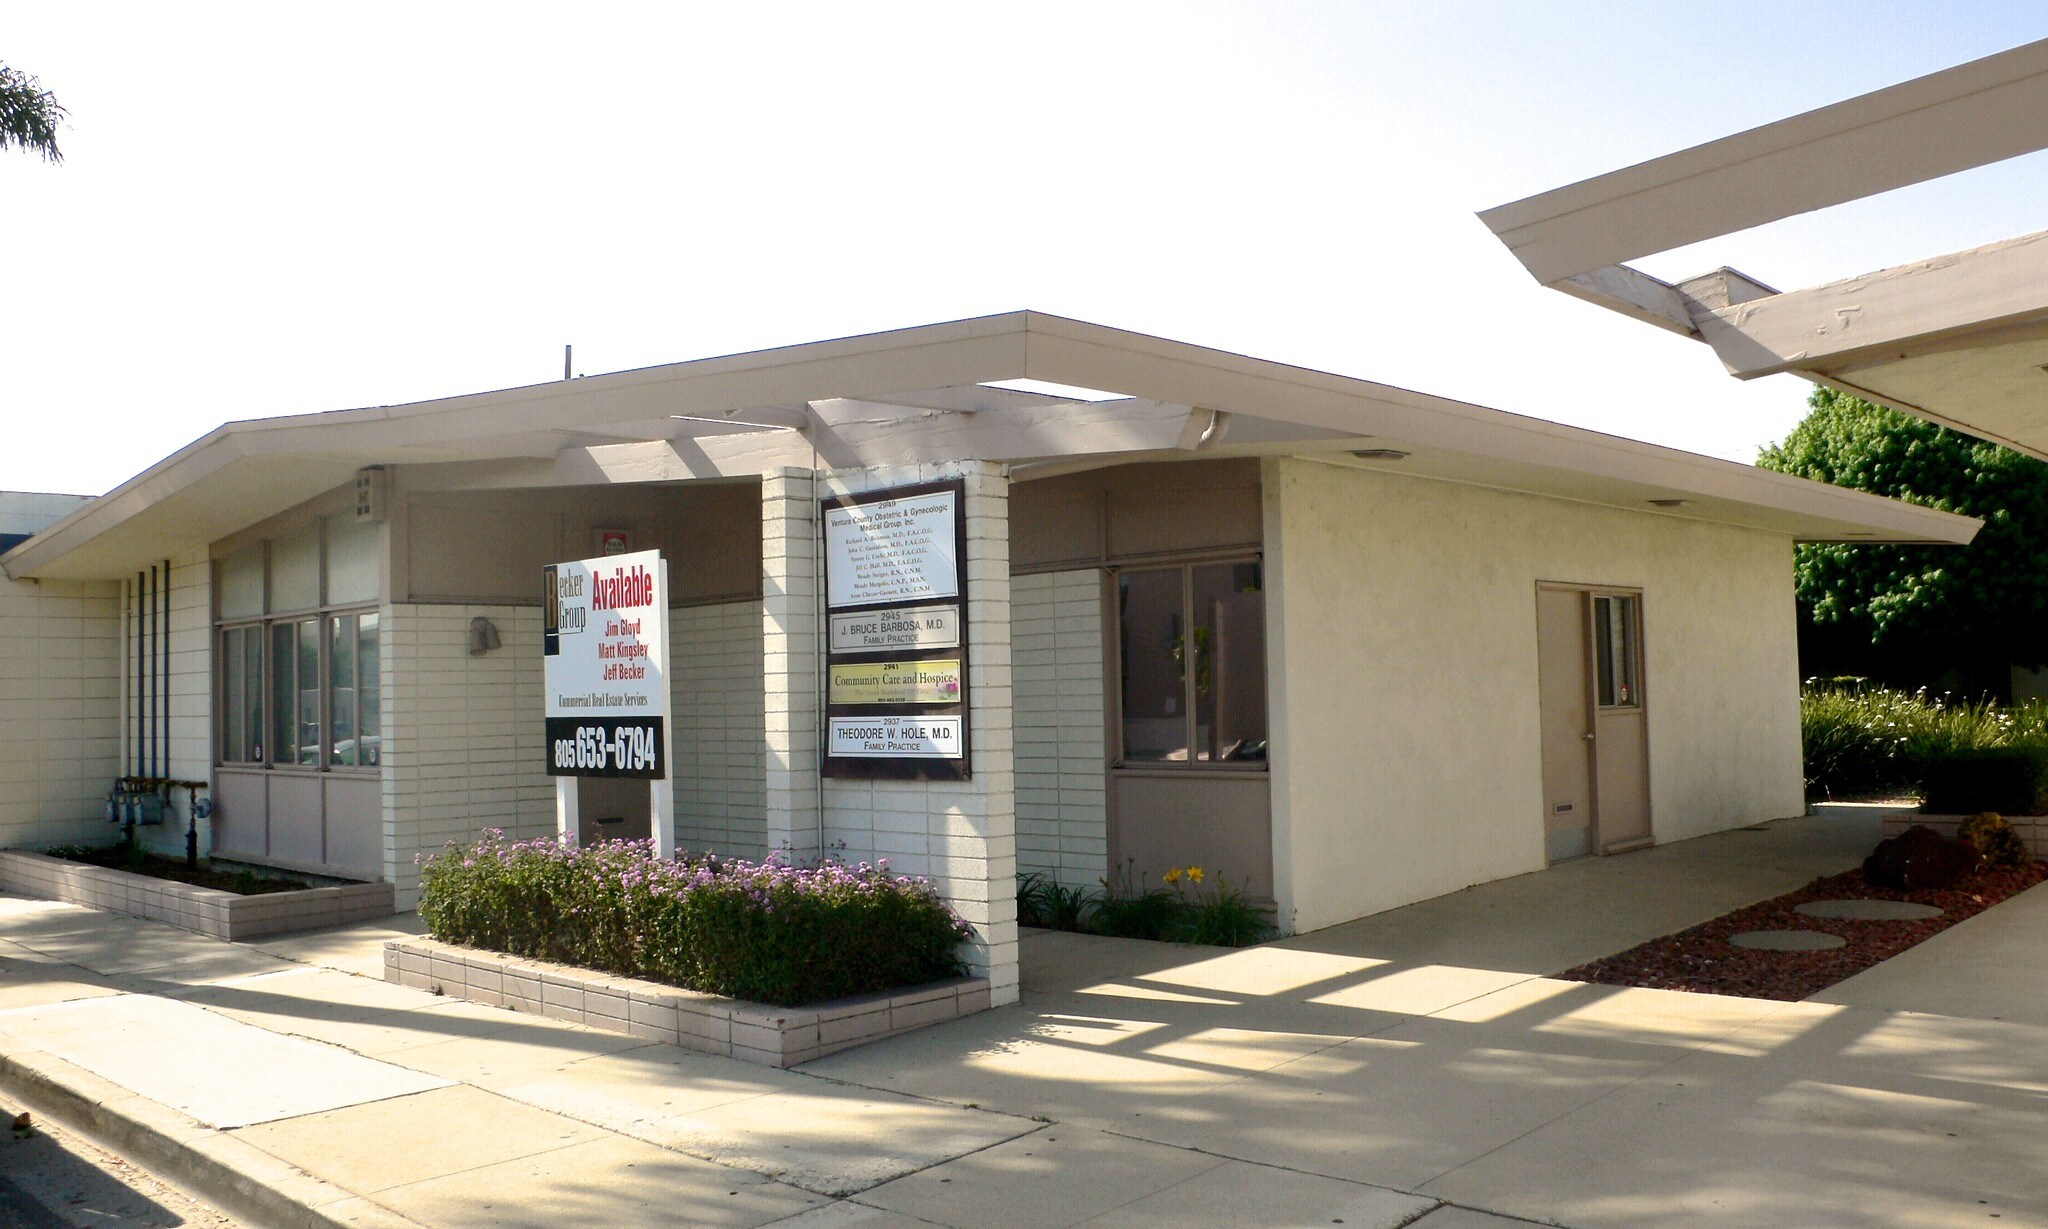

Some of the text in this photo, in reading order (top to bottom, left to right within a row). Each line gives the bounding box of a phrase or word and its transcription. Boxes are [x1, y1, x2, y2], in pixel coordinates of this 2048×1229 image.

[831, 504, 948, 527] Ventura County Obstetric & Gynecologic
[860, 521, 882, 532] Medical
[904, 518, 915, 527] Inc.
[592, 565, 653, 611] Available
[559, 600, 586, 632] Group
[881, 612, 901, 621] 2945
[605, 618, 640, 639] Jim Gloyd
[842, 619, 945, 635] J. BRUCE BARBOSA, M.D.
[598, 641, 649, 661] Matt Kingsley
[603, 663, 645, 680] Jeff Becker
[883, 663, 899, 671] 2941
[835, 671, 954, 687] Community Care and Hospice
[592, 693, 604, 707] Real
[605, 693, 623, 706] Estate
[624, 692, 648, 706] Services
[837, 728, 953, 740] THEODORE W. HOLE, M.D.
